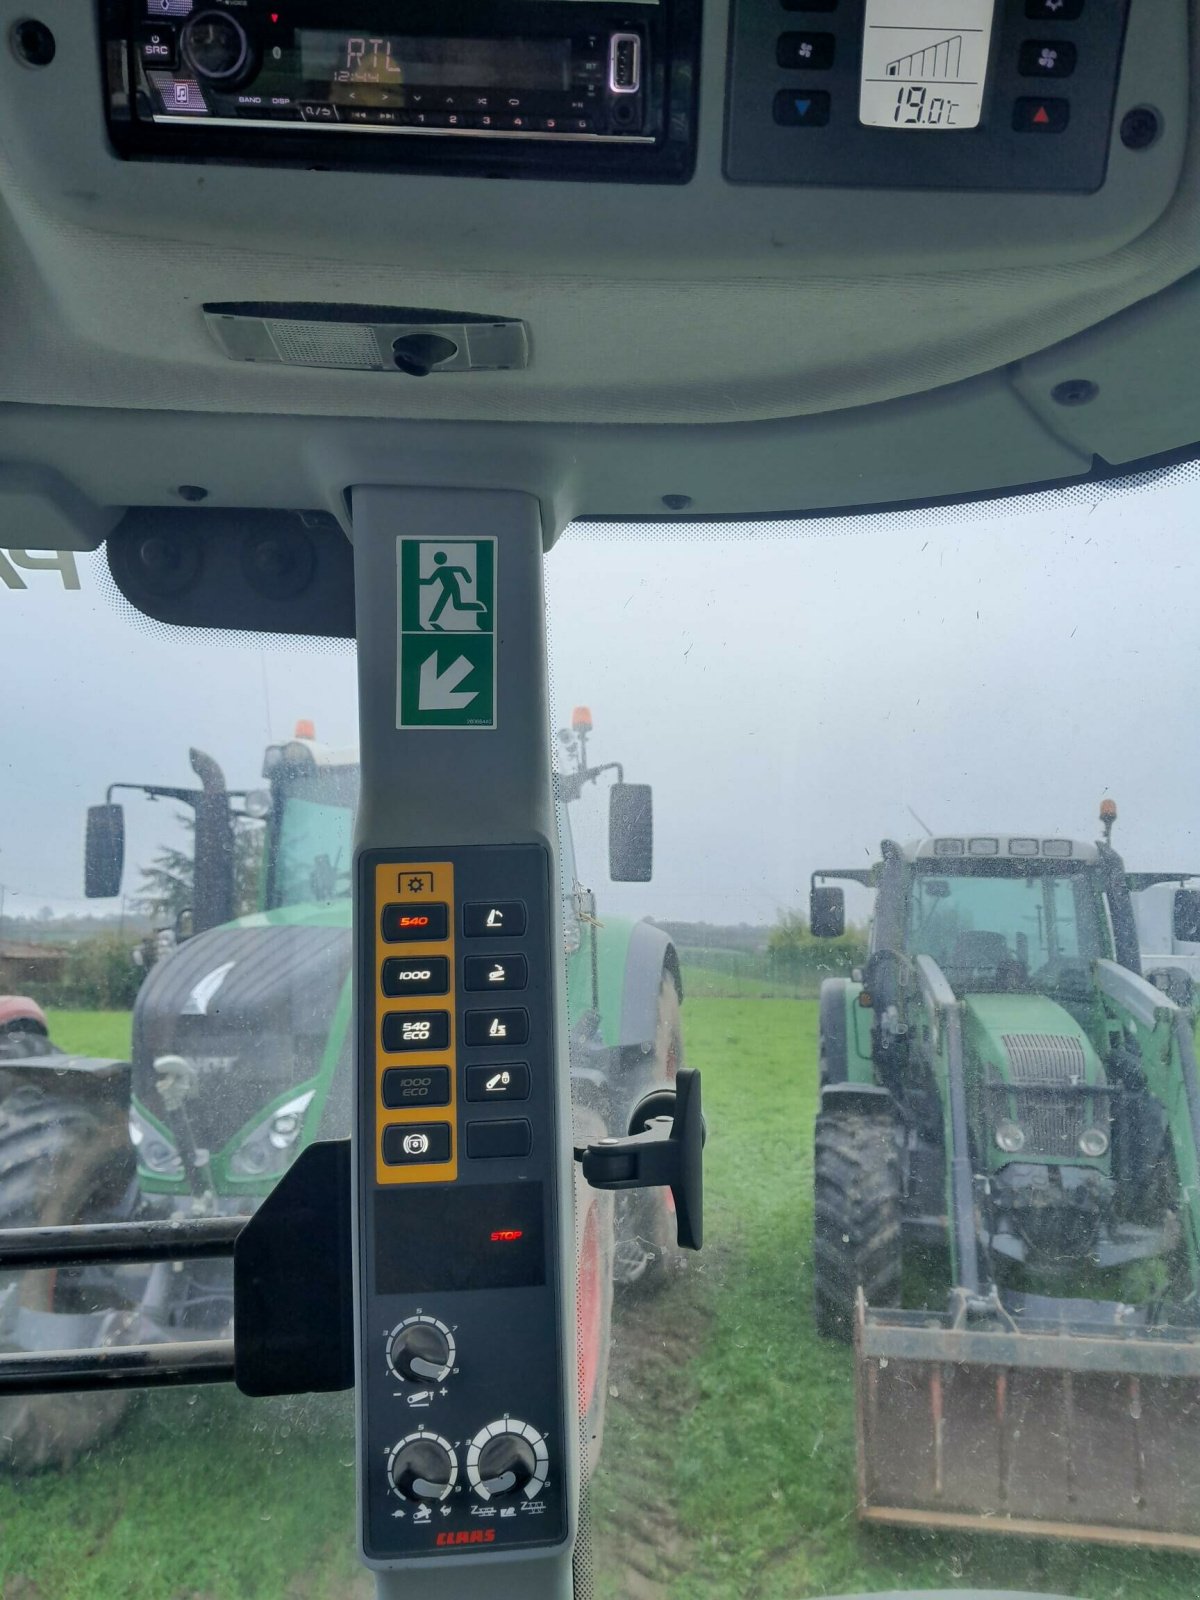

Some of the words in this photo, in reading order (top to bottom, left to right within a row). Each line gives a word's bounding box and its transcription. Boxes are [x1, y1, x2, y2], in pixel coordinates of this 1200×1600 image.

[145, 45, 168, 55] SRC
[346, 38, 401, 72] RTL
[334, 70, 380, 83] 12:44
[238, 96, 262, 104] BAND
[417, 114, 424, 122] 1
[449, 115, 457, 123] 2
[483, 116, 490, 124] 3
[514, 117, 522, 126] 4
[547, 119, 555, 127] 5
[400, 916, 429, 926] 540
[399, 970, 431, 980] 1000
[402, 1021, 431, 1031] 540
[403, 1031, 430, 1040] ECO
[400, 1077, 432, 1087] 1000
[402, 1087, 429, 1097] ECO
[490, 1231, 522, 1241] STOP
[436, 1528, 496, 1546] CLAAS
